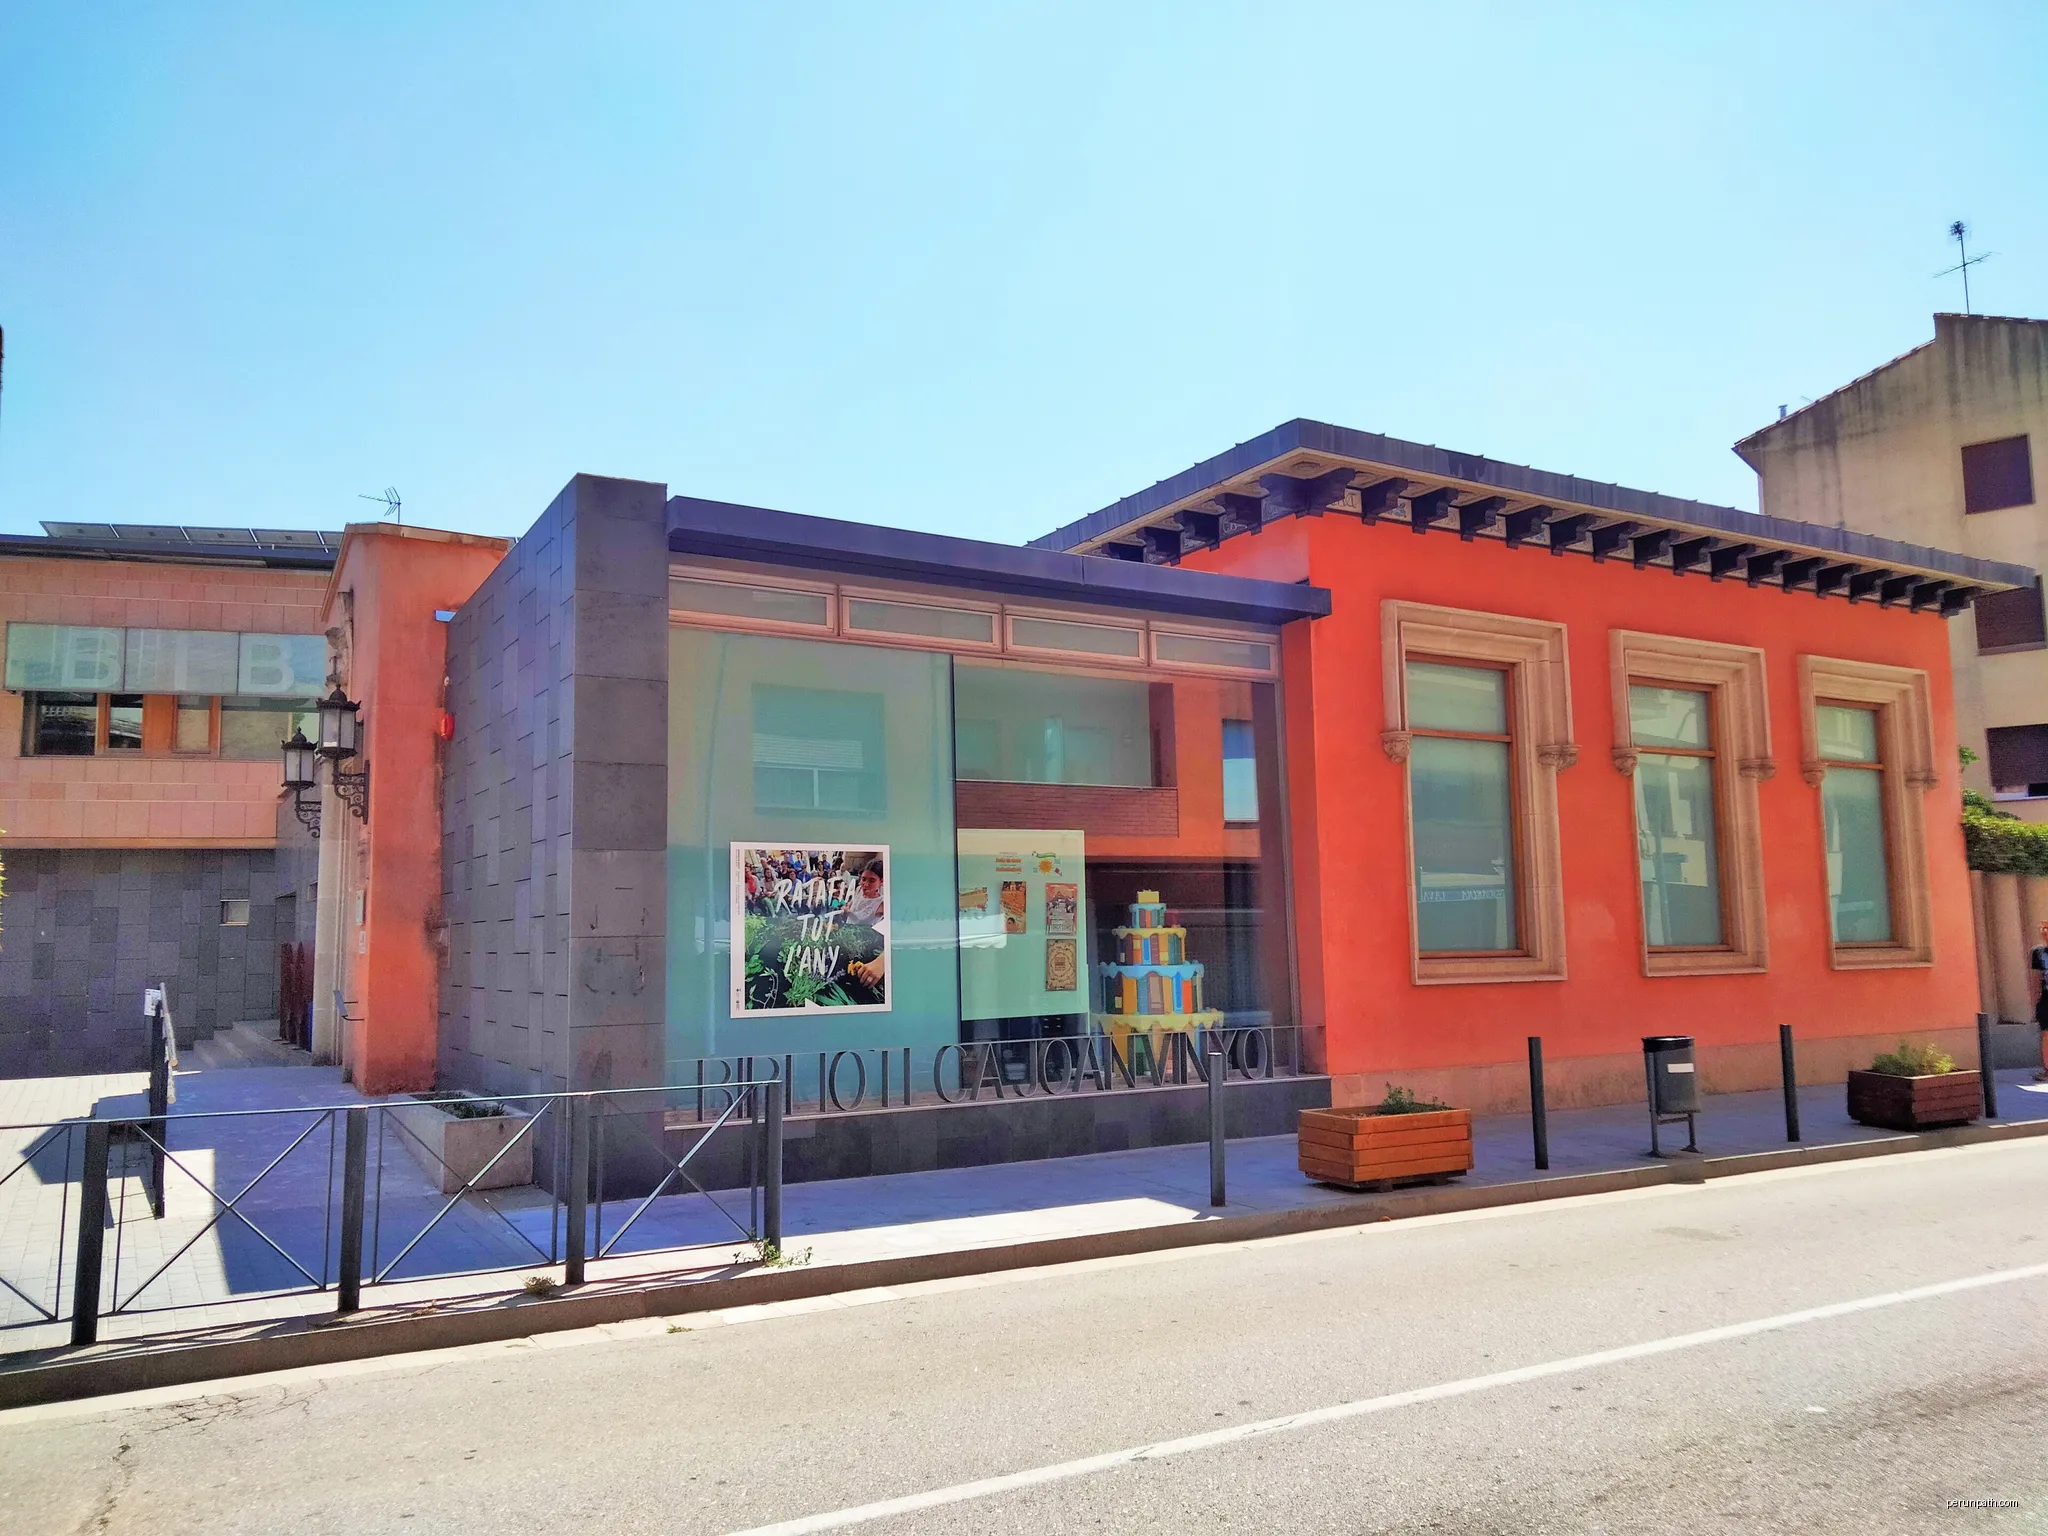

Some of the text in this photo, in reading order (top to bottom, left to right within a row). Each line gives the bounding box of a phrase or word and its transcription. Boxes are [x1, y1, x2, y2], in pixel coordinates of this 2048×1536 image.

[774, 876, 857, 915] RATAFIA
[797, 909, 845, 943] TOT
[783, 944, 841, 983] L'ANY
[1012, 1034, 1136, 1098] JOAN
